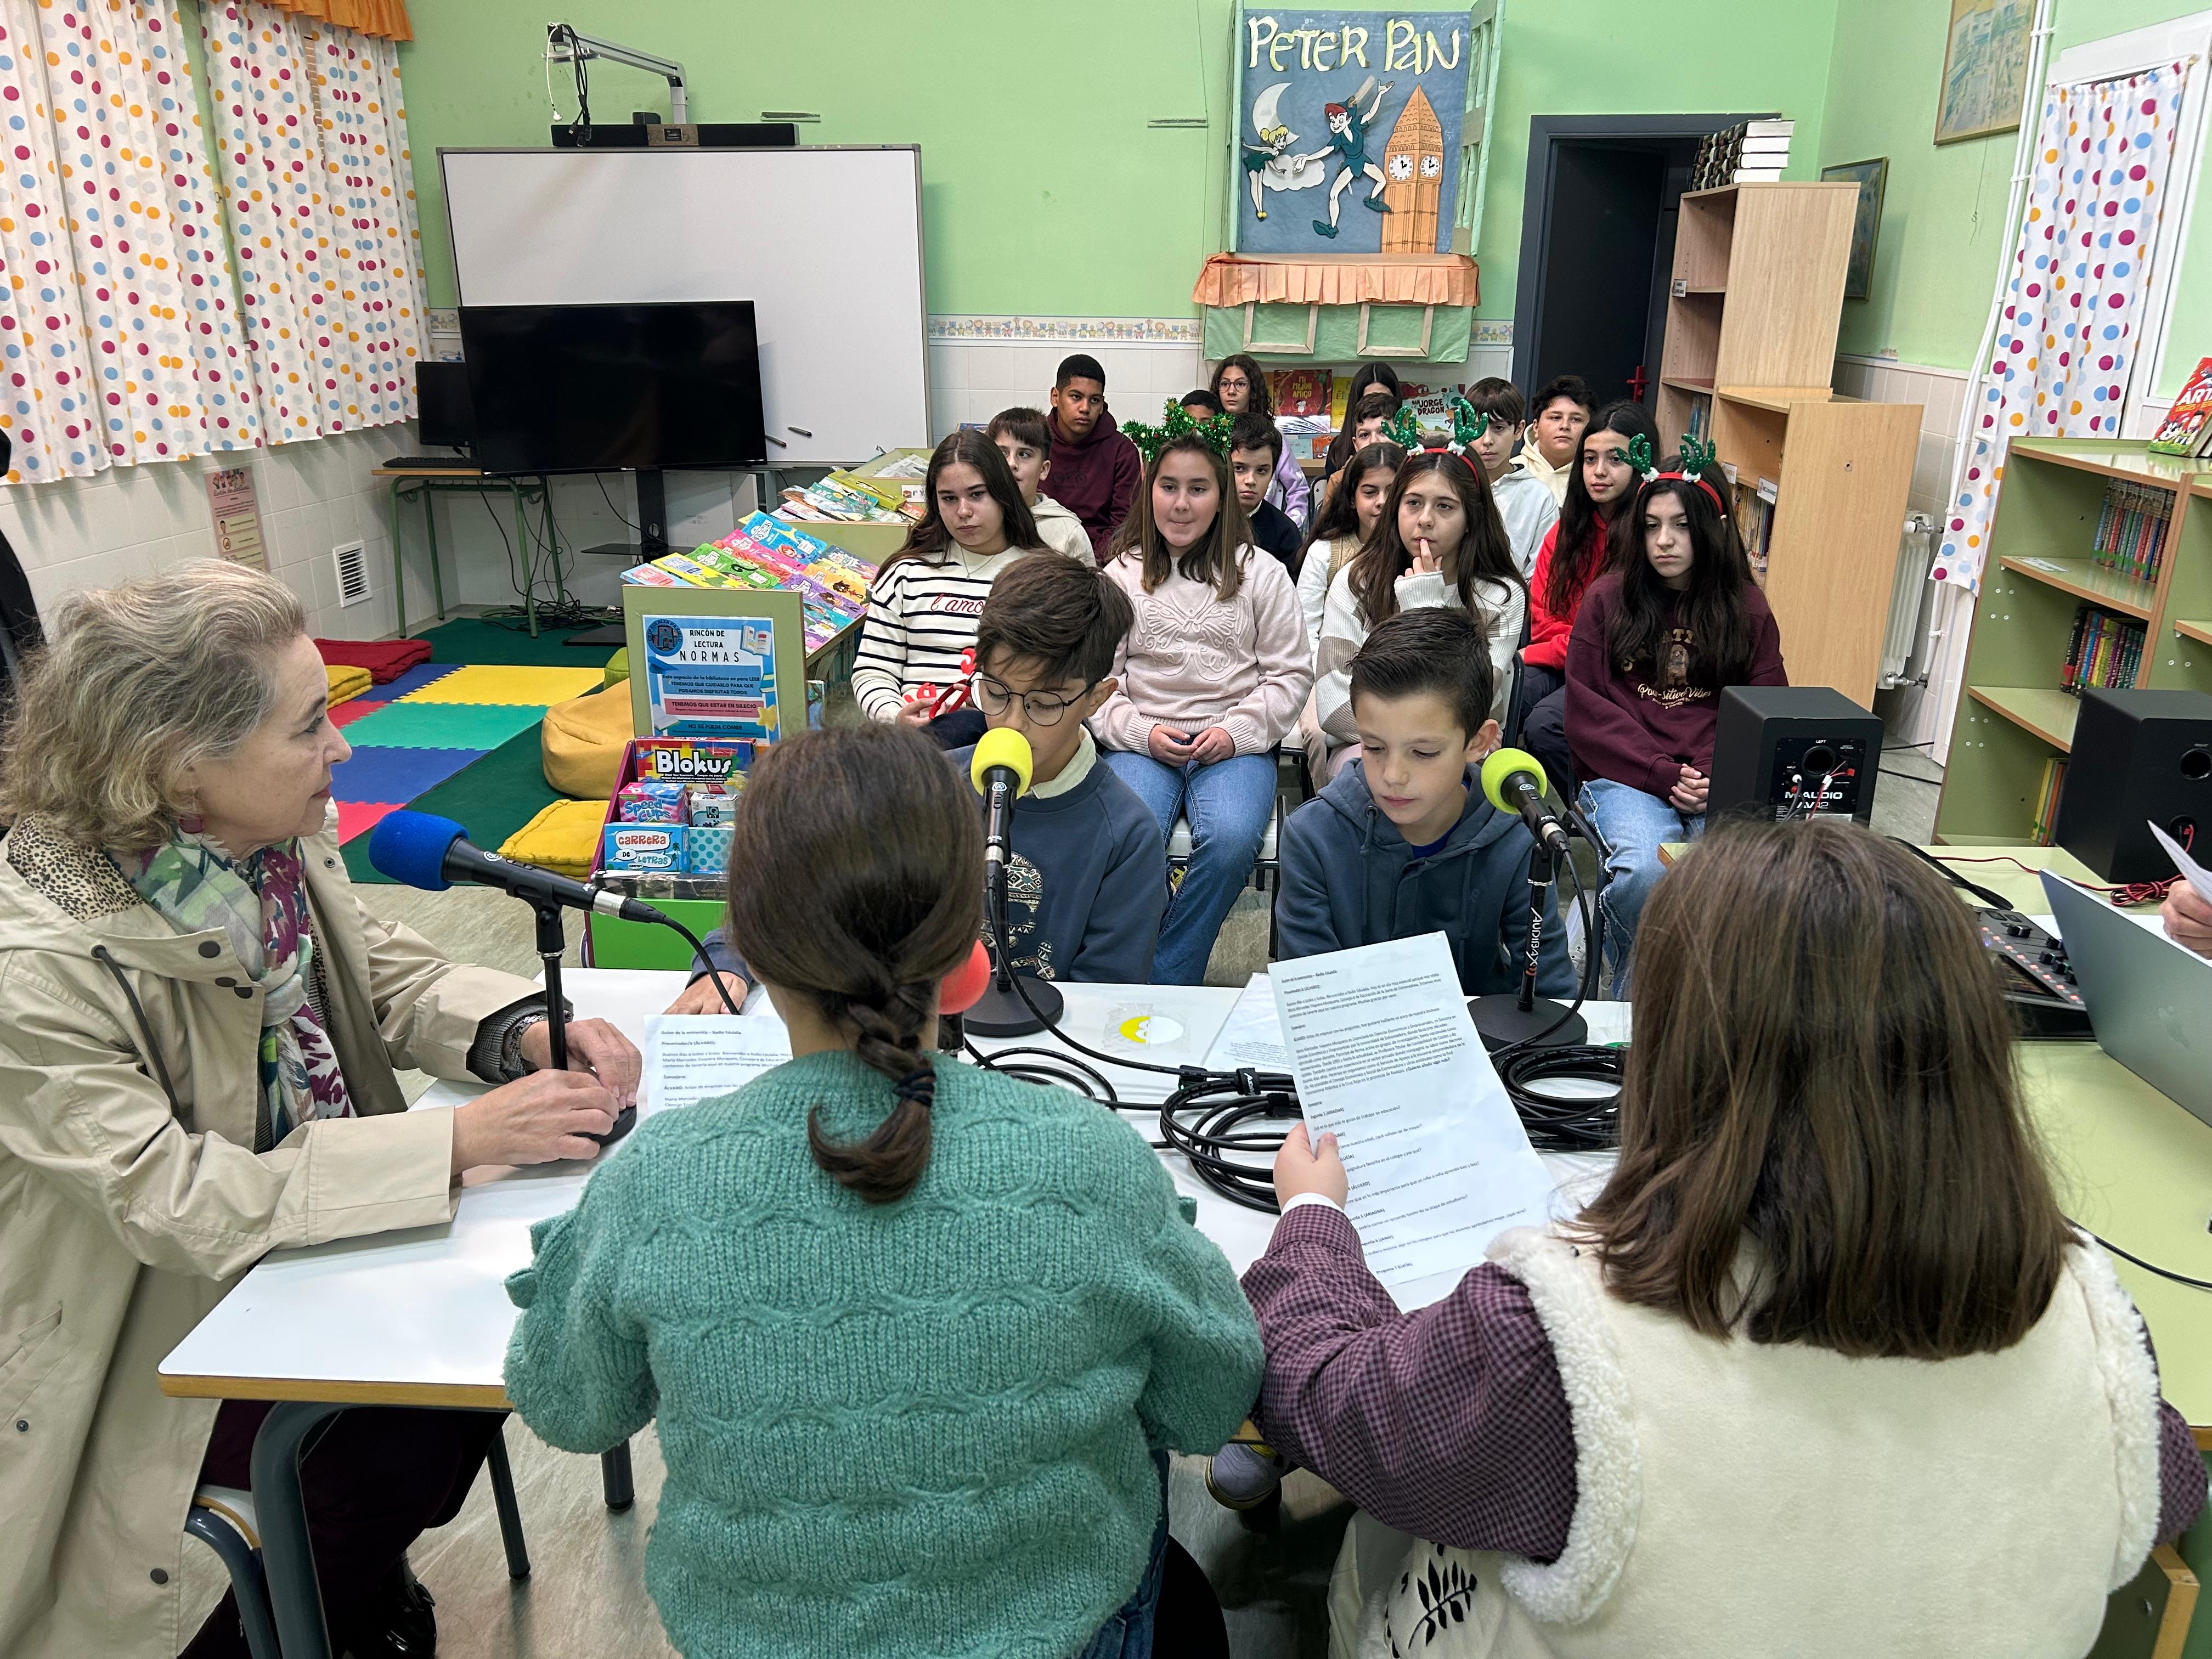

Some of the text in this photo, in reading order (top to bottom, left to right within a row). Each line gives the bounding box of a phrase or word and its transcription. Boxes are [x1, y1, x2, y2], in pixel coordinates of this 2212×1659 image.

[1419, 399, 1443, 408] JORGE
[1418, 406, 1444, 416] DRAGÓN
[690, 628, 714, 637] RINCÓN
[680, 650, 740, 663] NORMAS
[656, 751, 732, 775] Blokus
[624, 798, 663, 816] Speed
[707, 807, 719, 815] IQ
[638, 808, 672, 822] Cups
